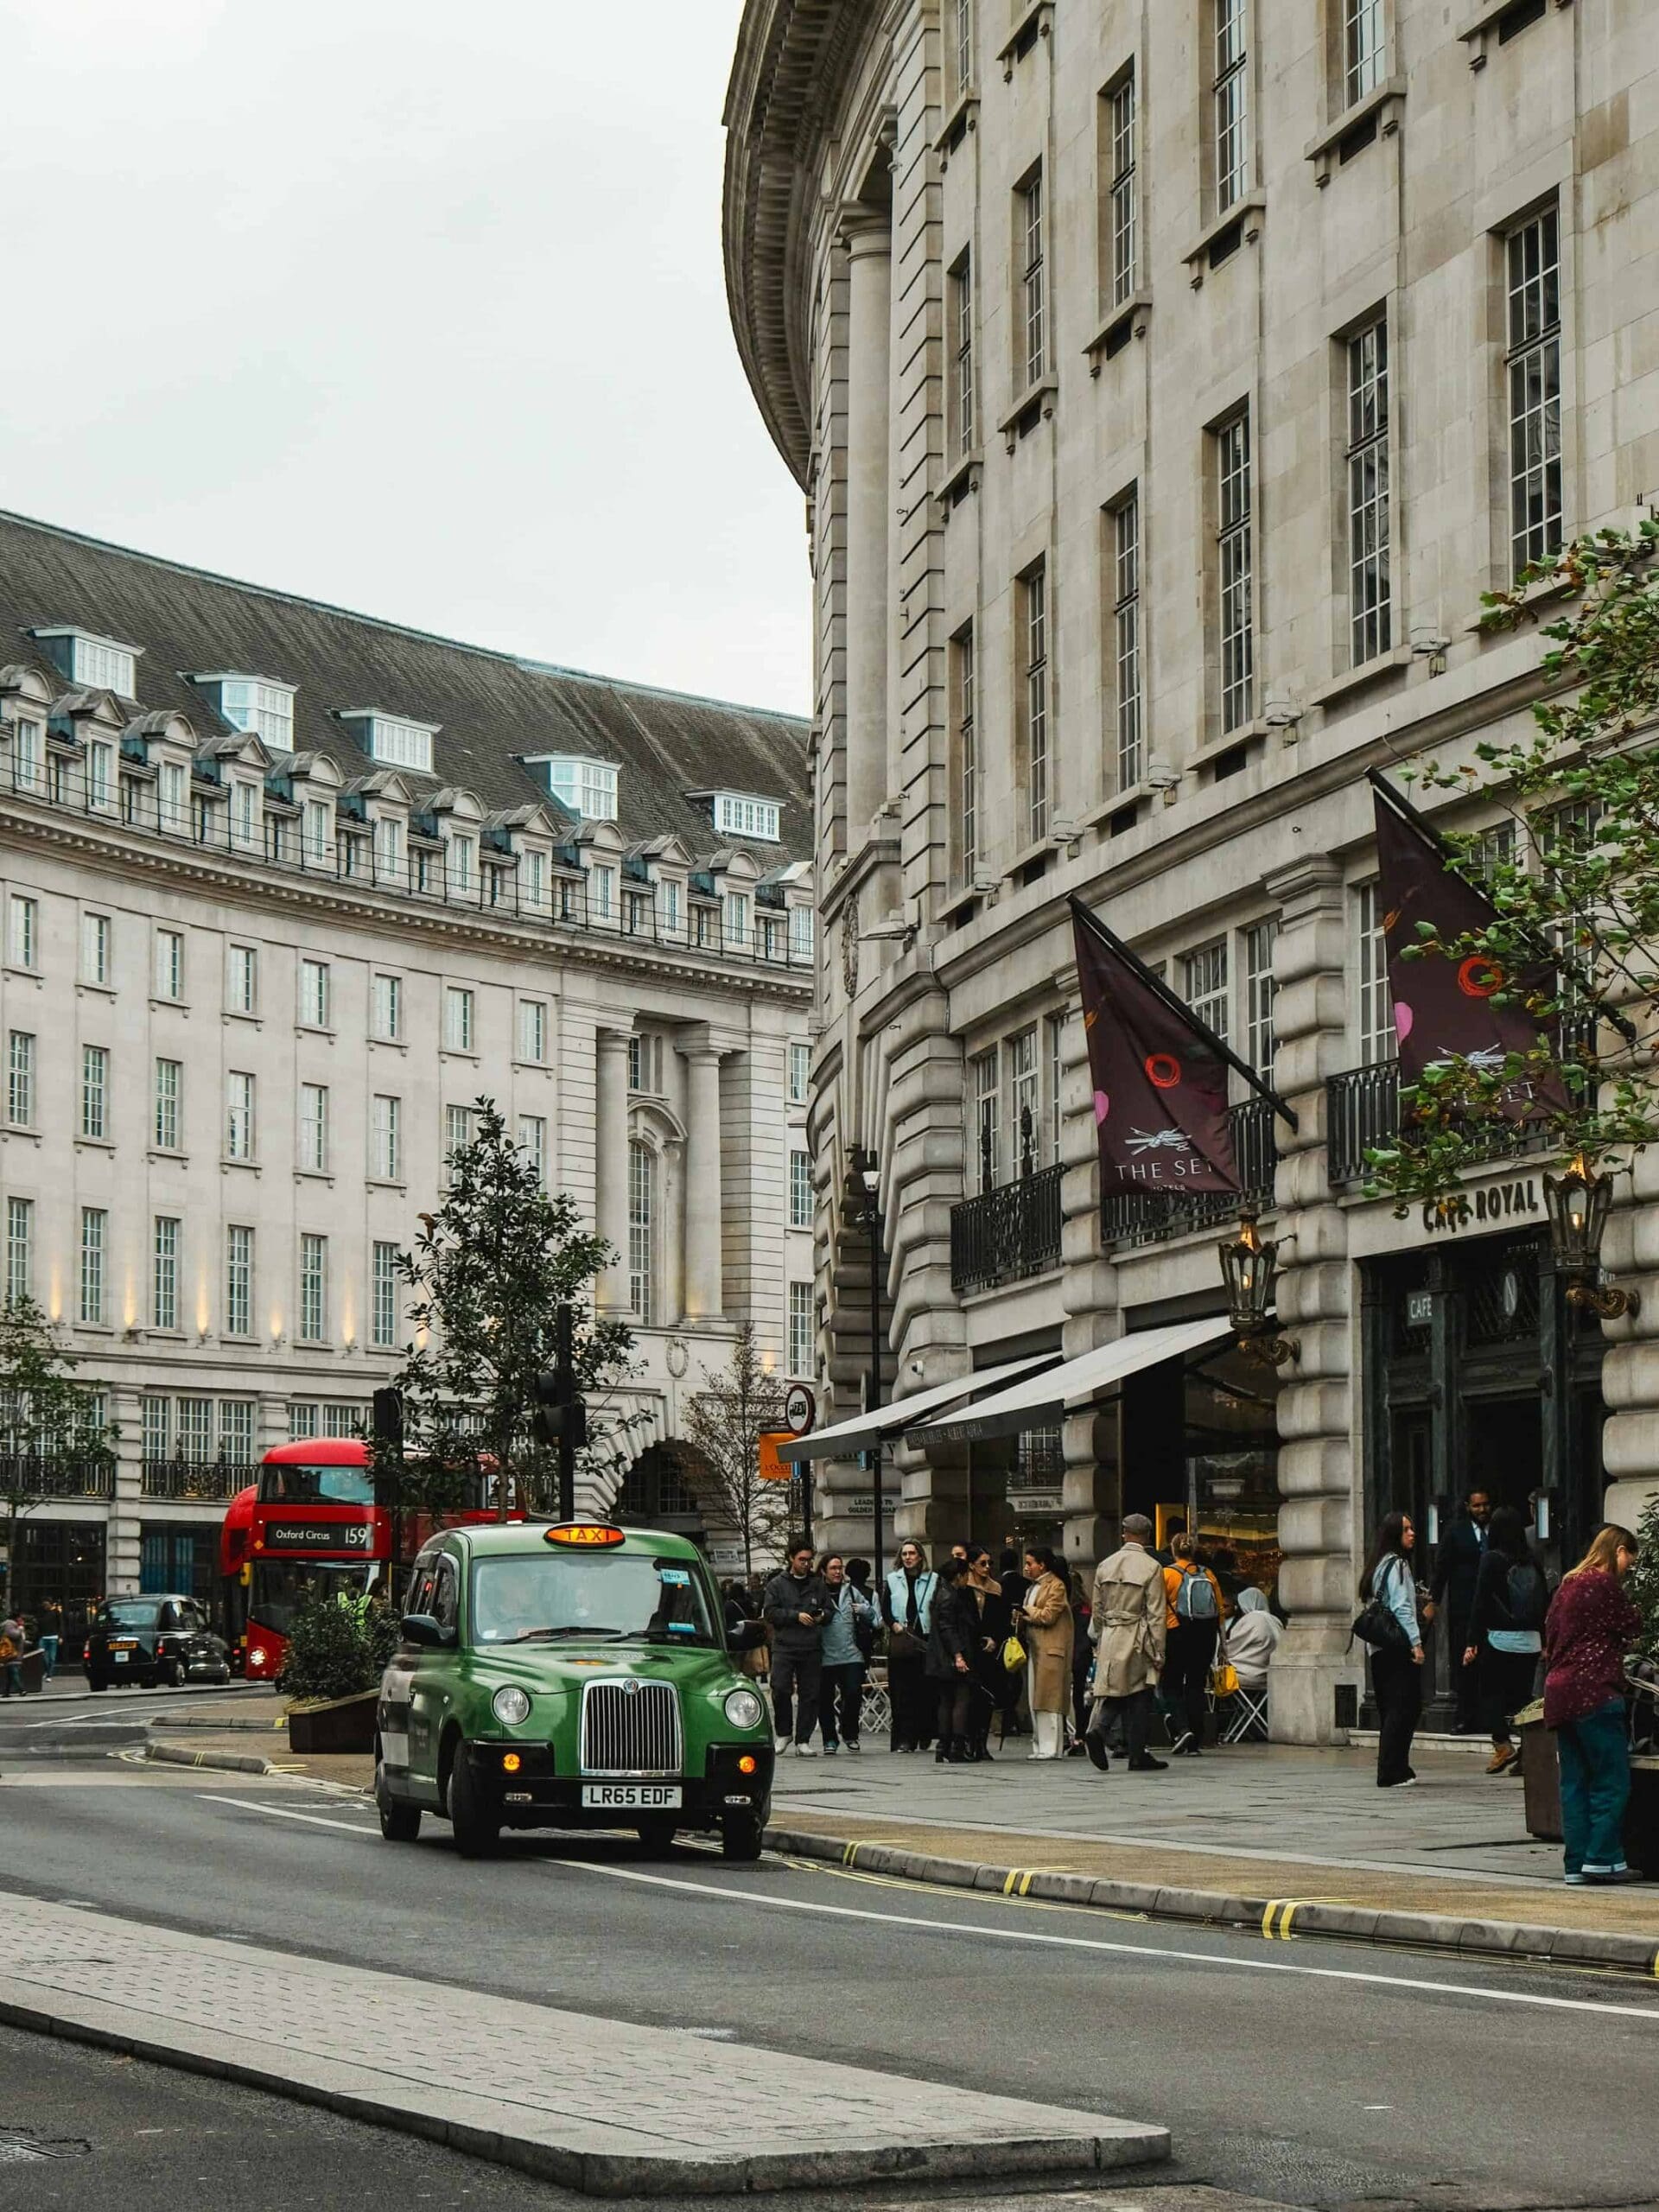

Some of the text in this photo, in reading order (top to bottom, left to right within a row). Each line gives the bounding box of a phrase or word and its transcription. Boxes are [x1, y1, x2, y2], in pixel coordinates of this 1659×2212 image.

[1115, 1162, 1163, 1180] THE
[1476, 1180, 1538, 1221] ROYAL
[276, 1528, 367, 1544] Oxford Circus 159
[564, 1529, 610, 1541] TAXI
[589, 1787, 675, 1805] LR65 EDF
